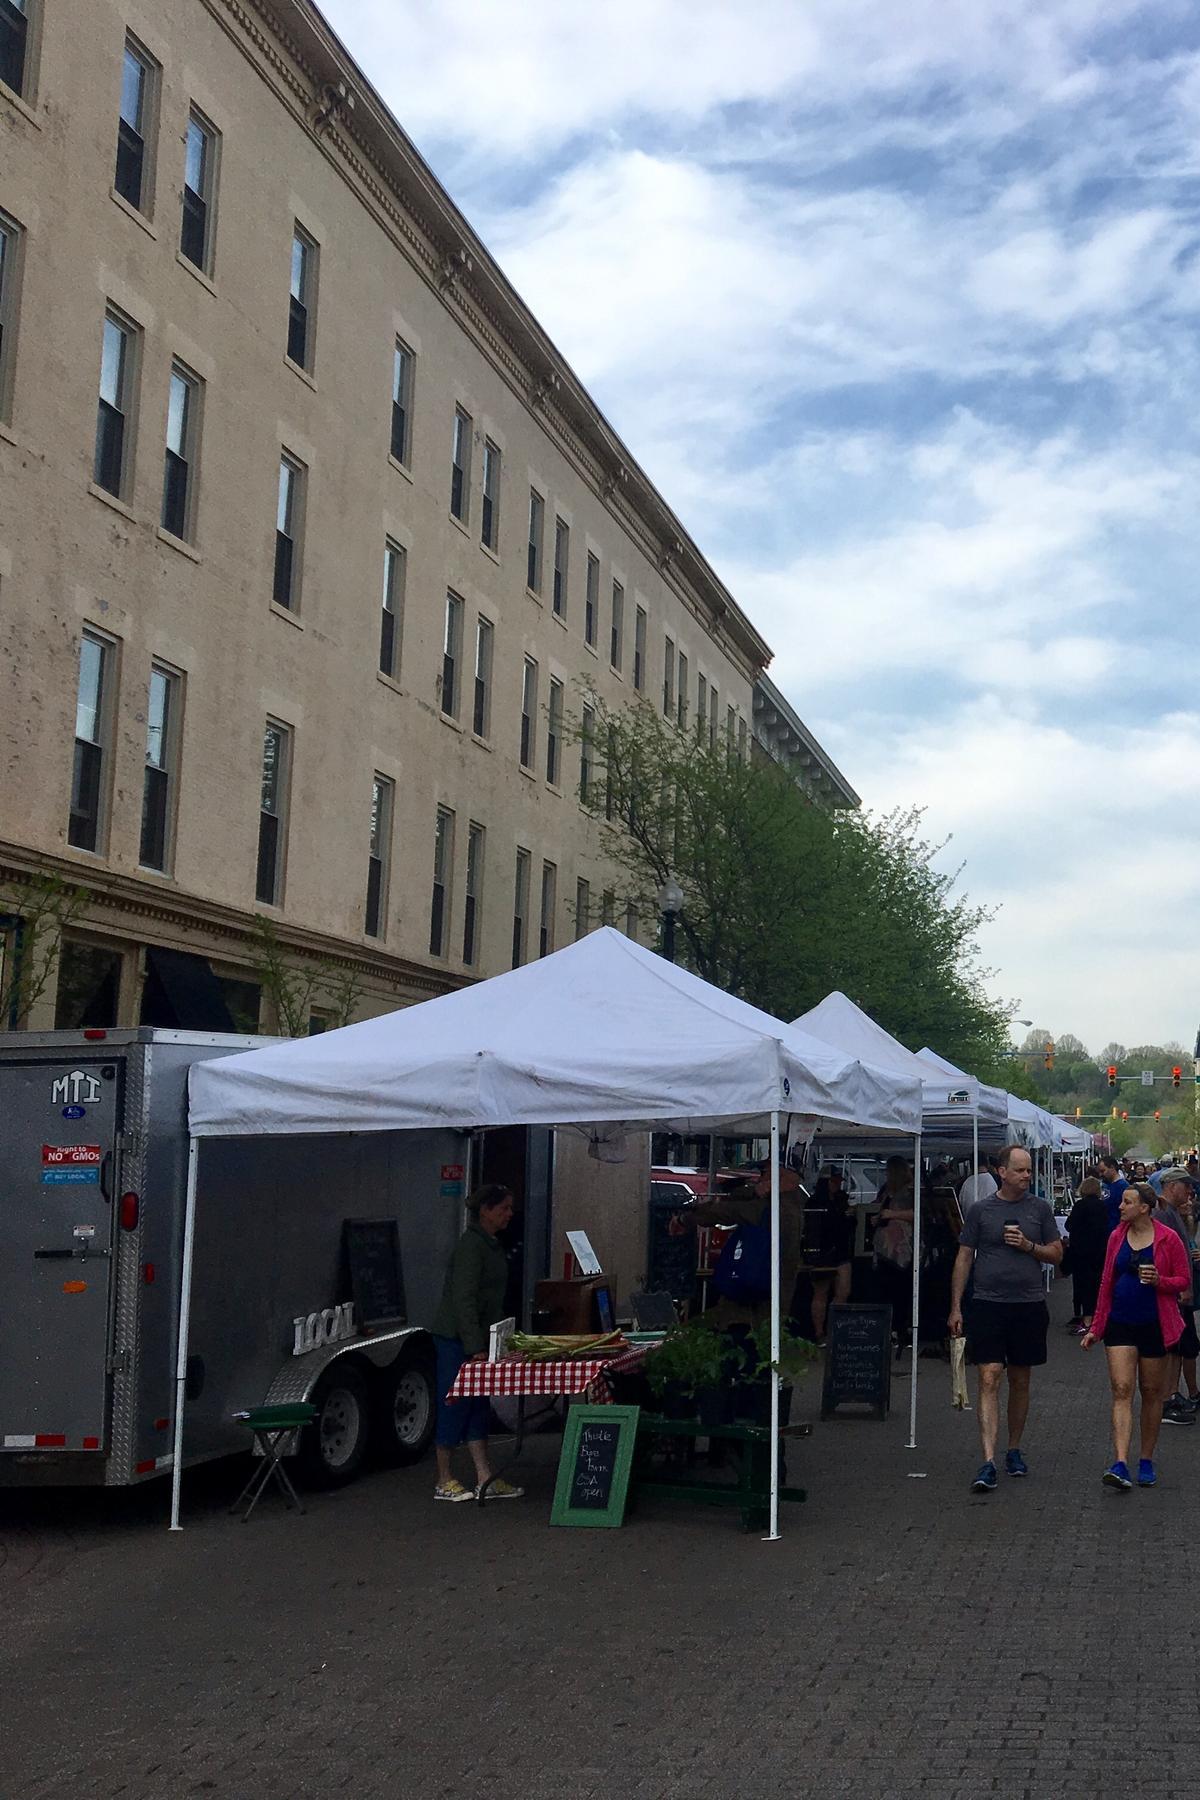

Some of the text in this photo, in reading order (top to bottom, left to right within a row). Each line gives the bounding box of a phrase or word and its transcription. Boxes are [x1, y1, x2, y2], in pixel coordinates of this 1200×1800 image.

[51, 1070, 101, 1104] MTI
[72, 1151, 100, 1161] GMOs
[293, 1302, 358, 1356] LOCAL
